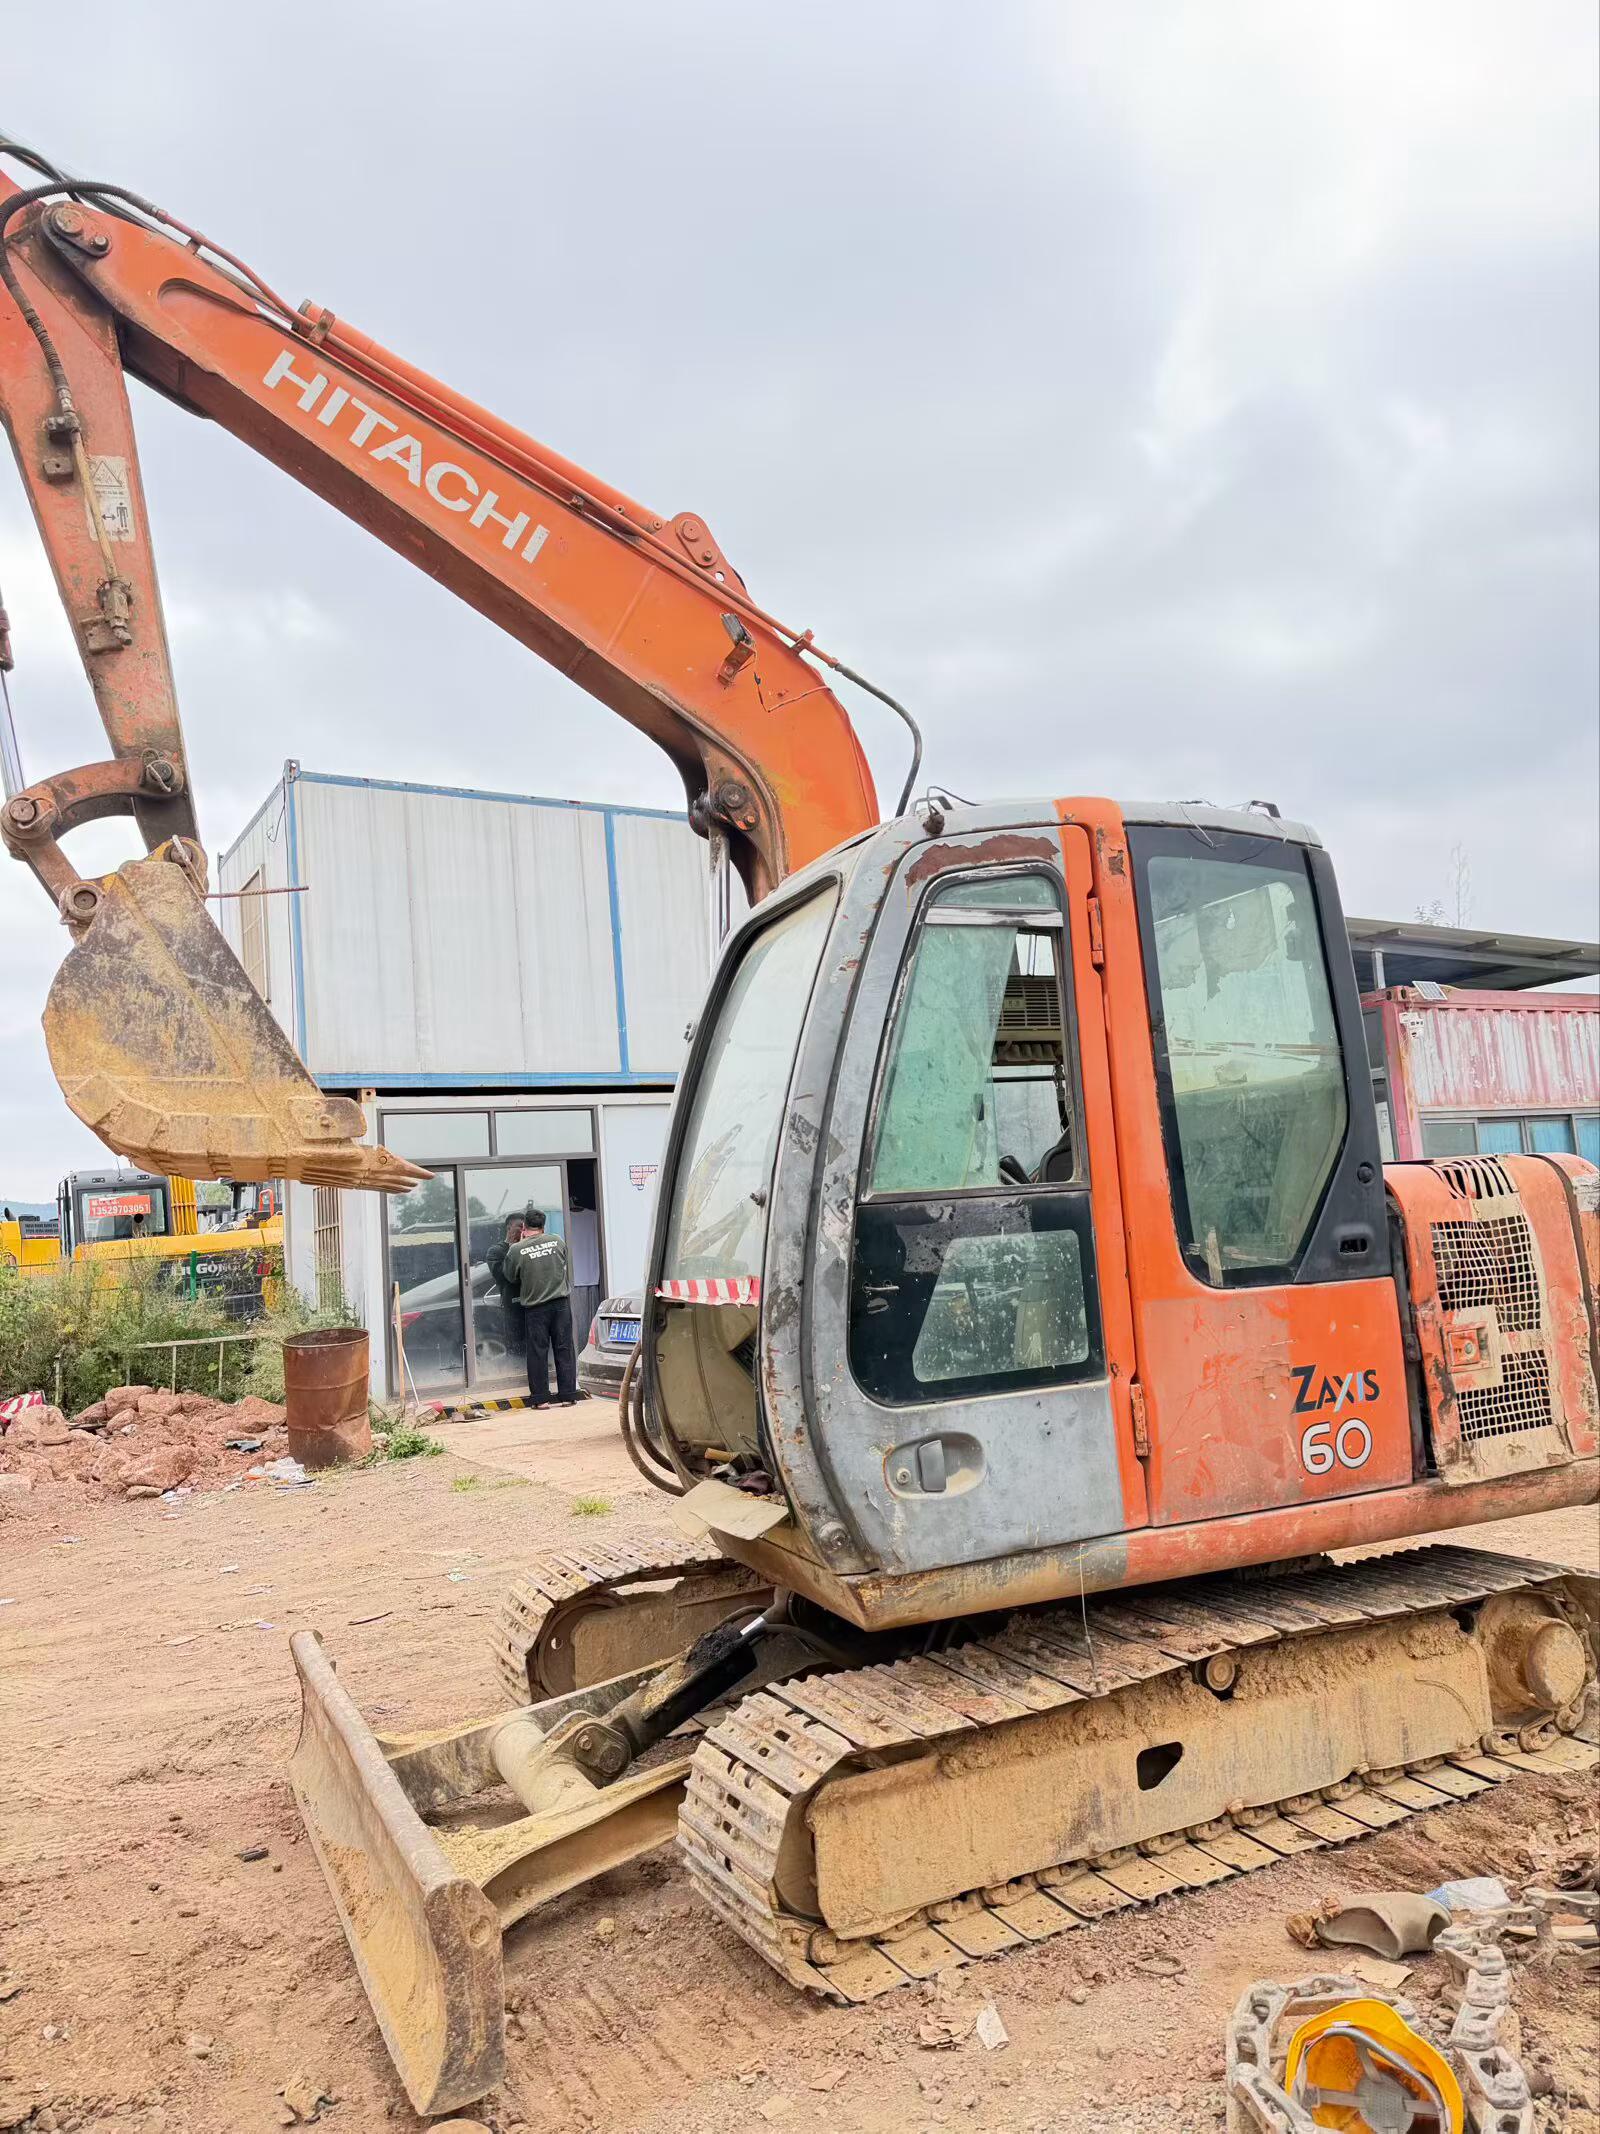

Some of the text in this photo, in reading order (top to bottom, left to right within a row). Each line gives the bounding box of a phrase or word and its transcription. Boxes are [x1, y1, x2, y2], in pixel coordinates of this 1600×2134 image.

[262, 349, 550, 564] HITACHI
[1290, 1365, 1380, 1414] ZAXIS
[1301, 1418, 1373, 1475] 60
